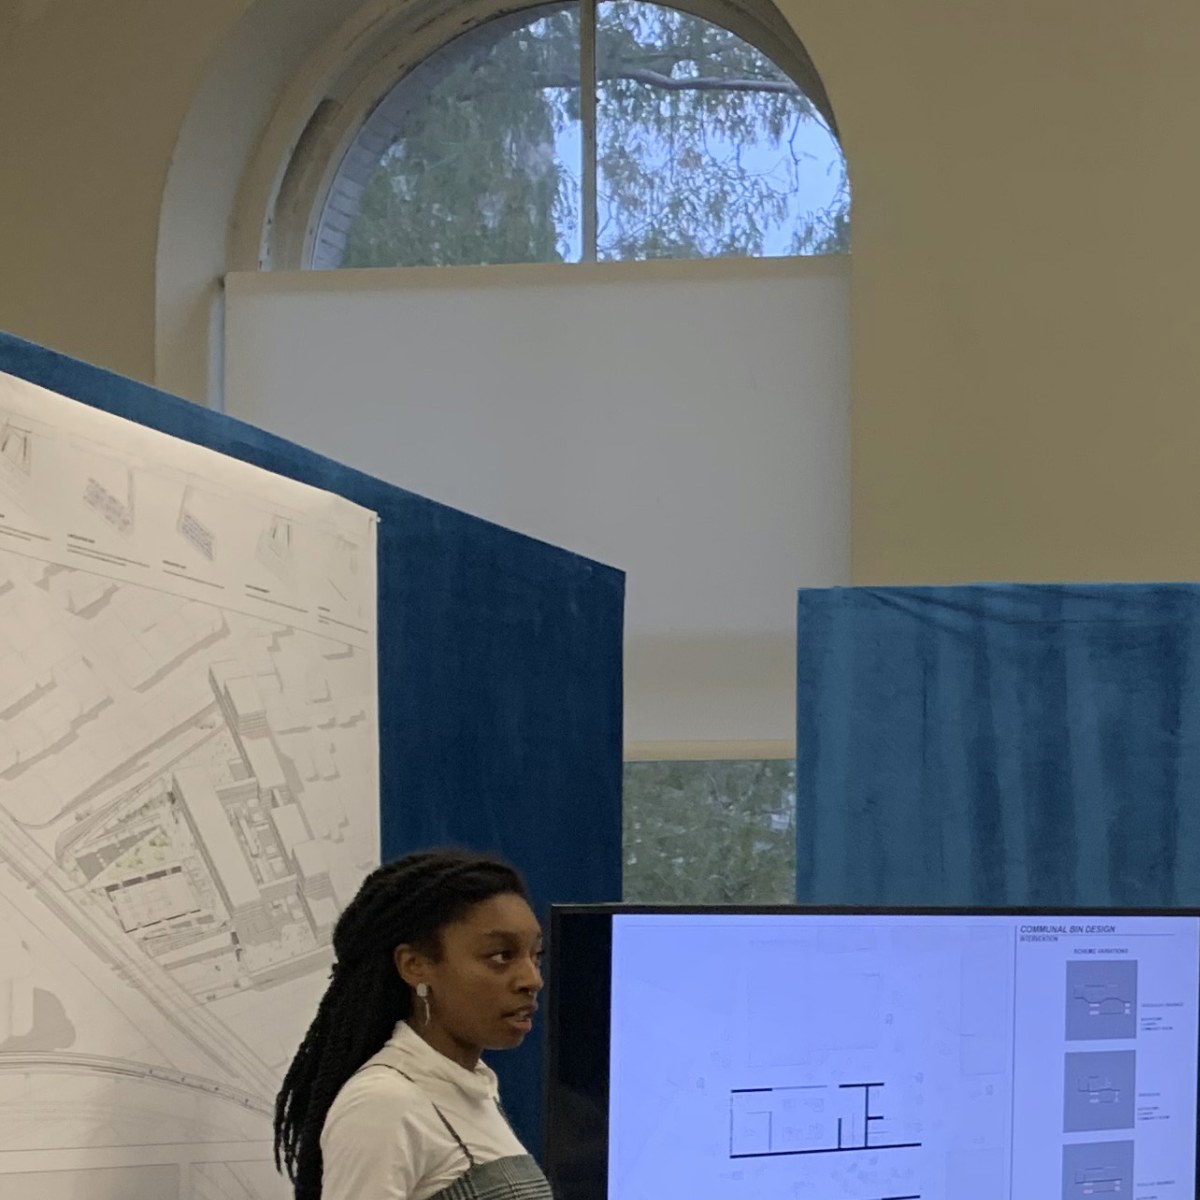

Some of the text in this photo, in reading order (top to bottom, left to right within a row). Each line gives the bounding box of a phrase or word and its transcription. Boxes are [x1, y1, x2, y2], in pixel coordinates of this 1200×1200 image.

[1020, 925, 1116, 933] COMMUNAL BIN DESIGN
